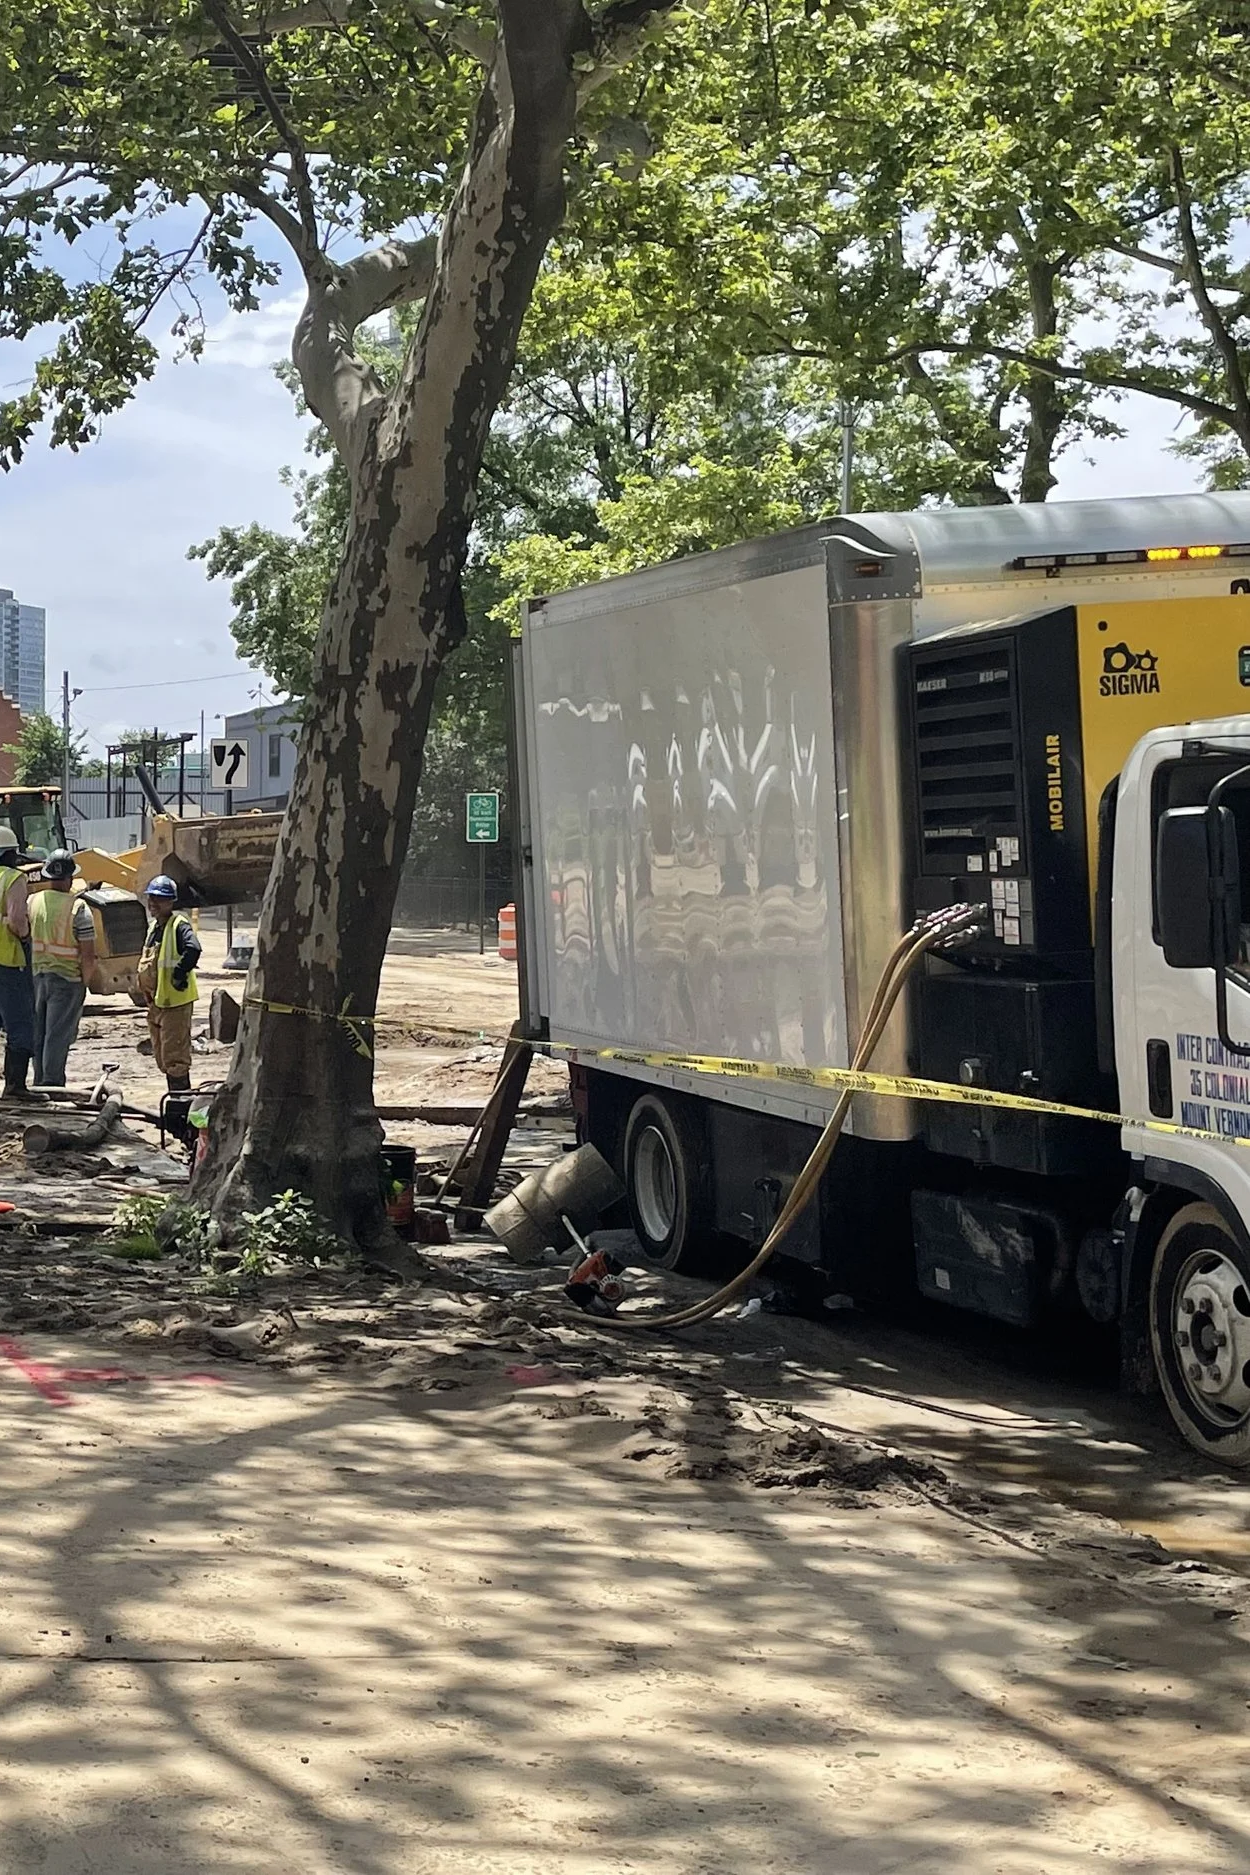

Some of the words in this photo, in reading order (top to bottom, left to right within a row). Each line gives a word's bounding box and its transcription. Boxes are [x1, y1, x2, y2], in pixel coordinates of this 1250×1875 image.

[1099, 672, 1160, 697] SIGMA
[1046, 734, 1064, 830] MOBILAIR
[1176, 1033, 1203, 1063] INTER
[1190, 1069, 1202, 1097] 35
[1204, 1071, 1250, 1106] COLONIAL
[1181, 1101, 1211, 1132] MOUNT
